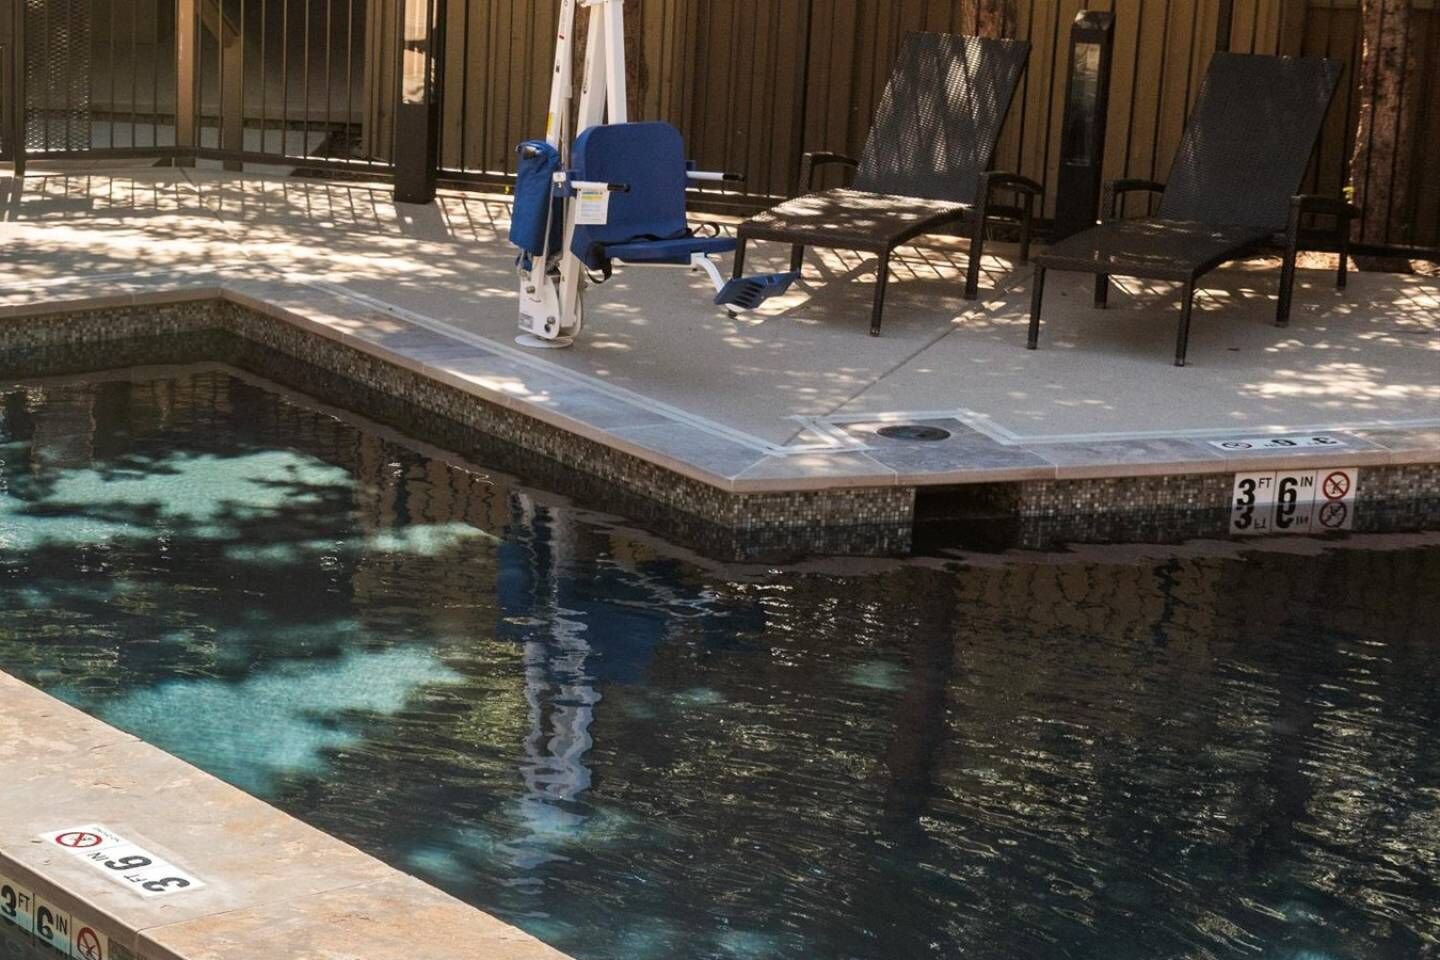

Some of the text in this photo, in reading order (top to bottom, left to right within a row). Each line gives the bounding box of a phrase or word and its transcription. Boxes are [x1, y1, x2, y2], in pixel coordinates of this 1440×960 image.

[1237, 476, 1313, 505] 3 FT 6 IN
[87, 850, 191, 893] 3 FT 6 IN
[0, 884, 68, 940] 3 FT 6 IN
